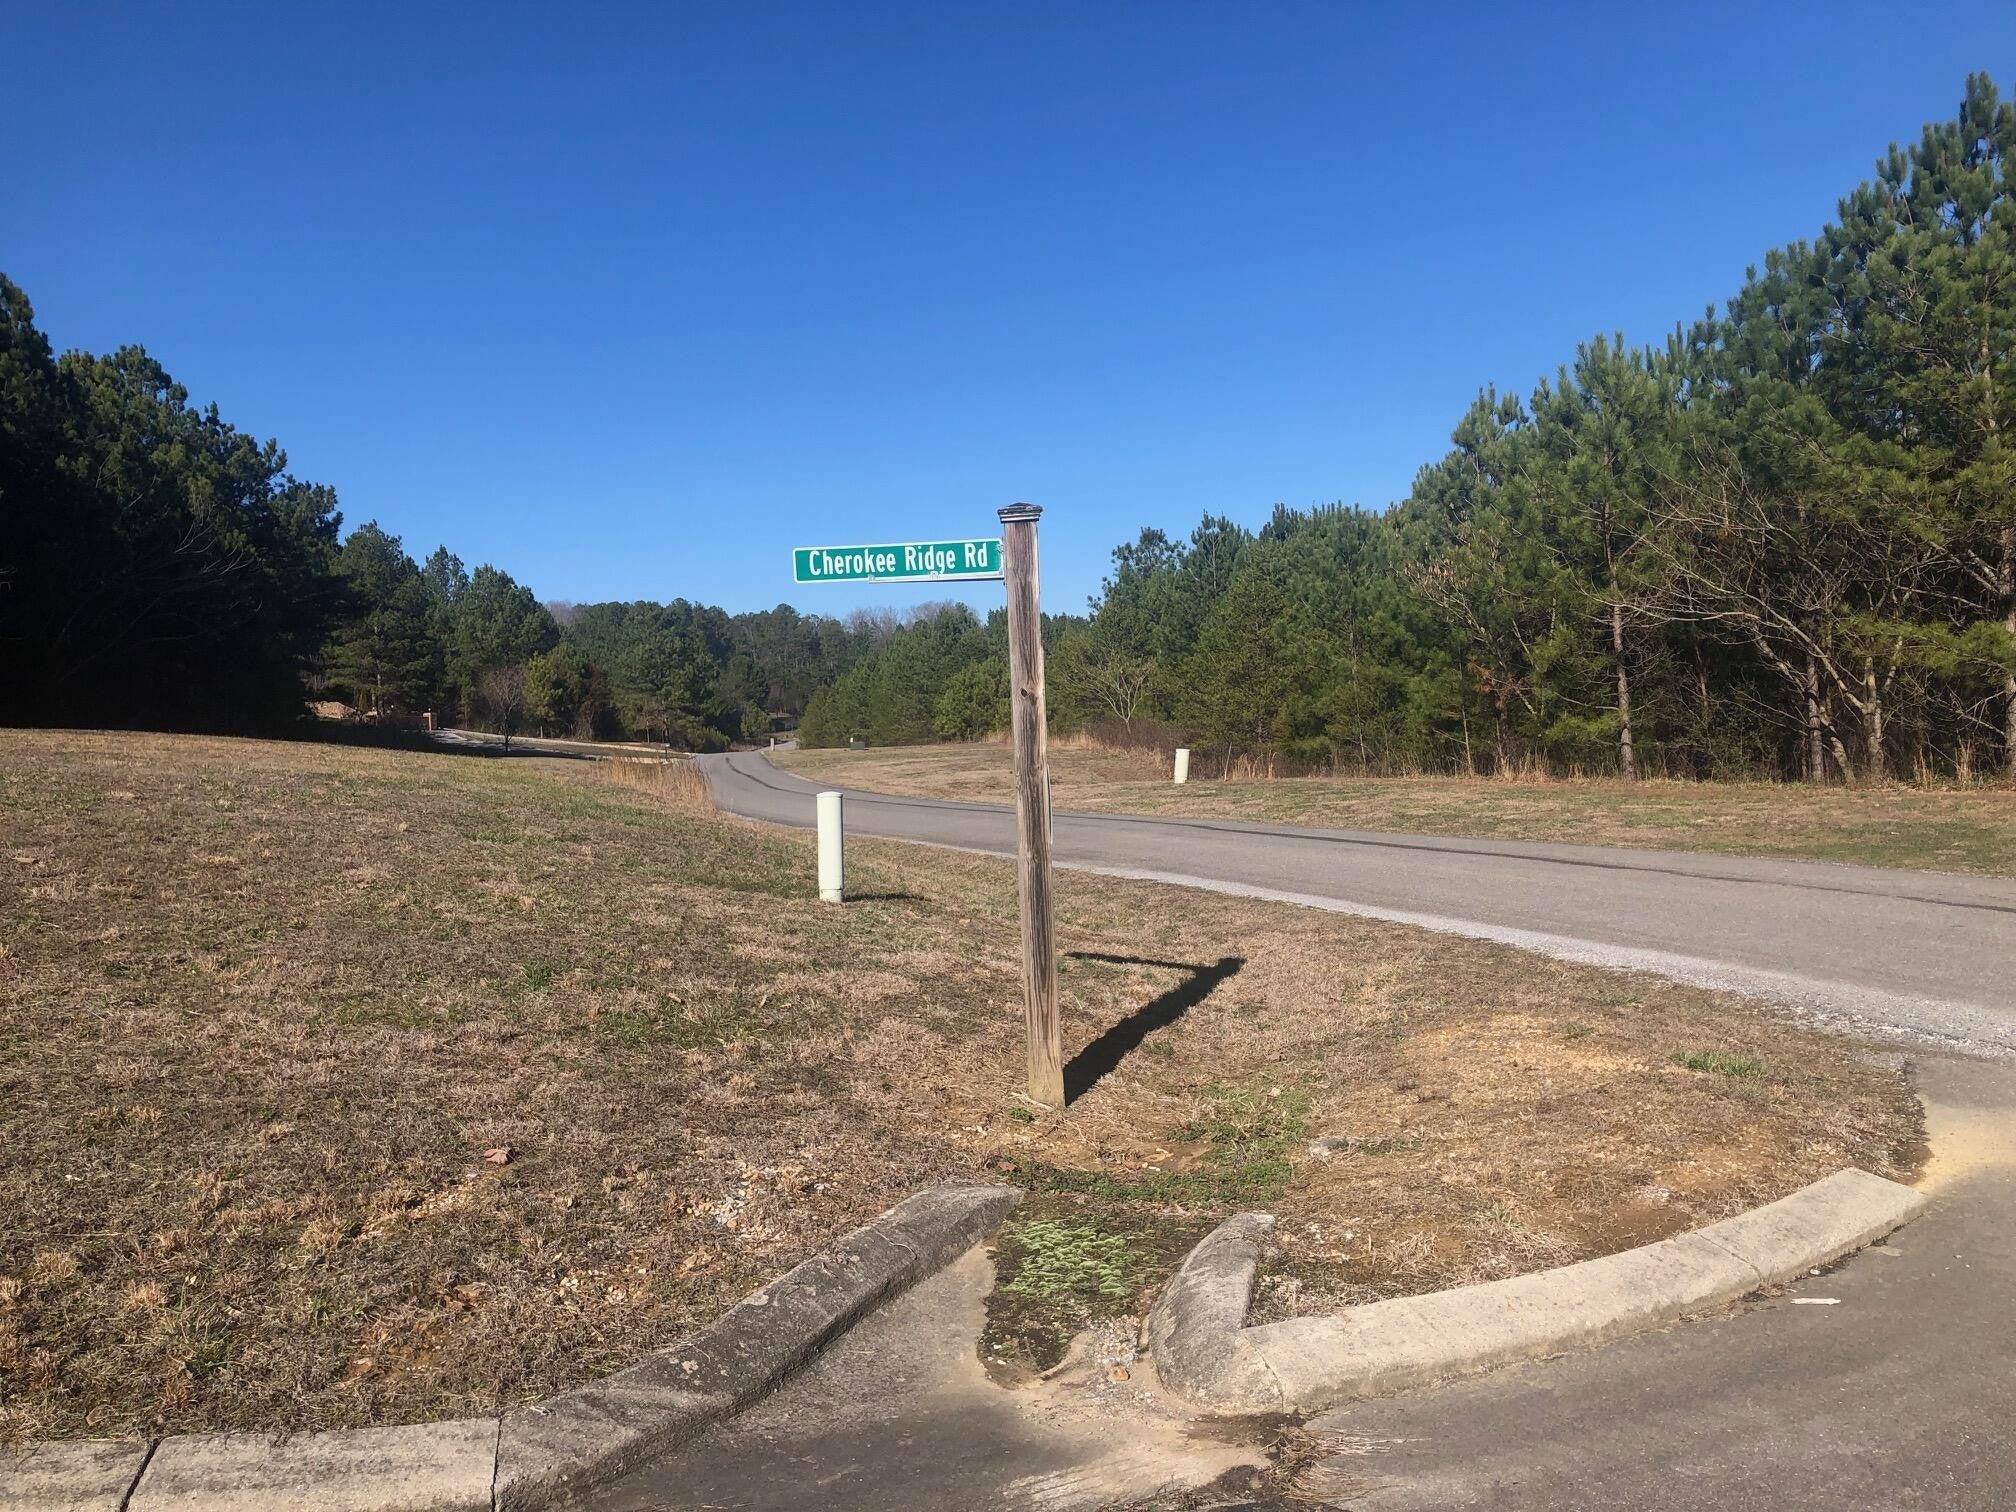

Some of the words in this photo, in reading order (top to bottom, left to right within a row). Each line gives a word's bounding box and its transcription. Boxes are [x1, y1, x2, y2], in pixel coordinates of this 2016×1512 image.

[809, 549, 896, 576] Cherokee
[905, 545, 956, 574] Ridge
[964, 543, 988, 568] Rd
